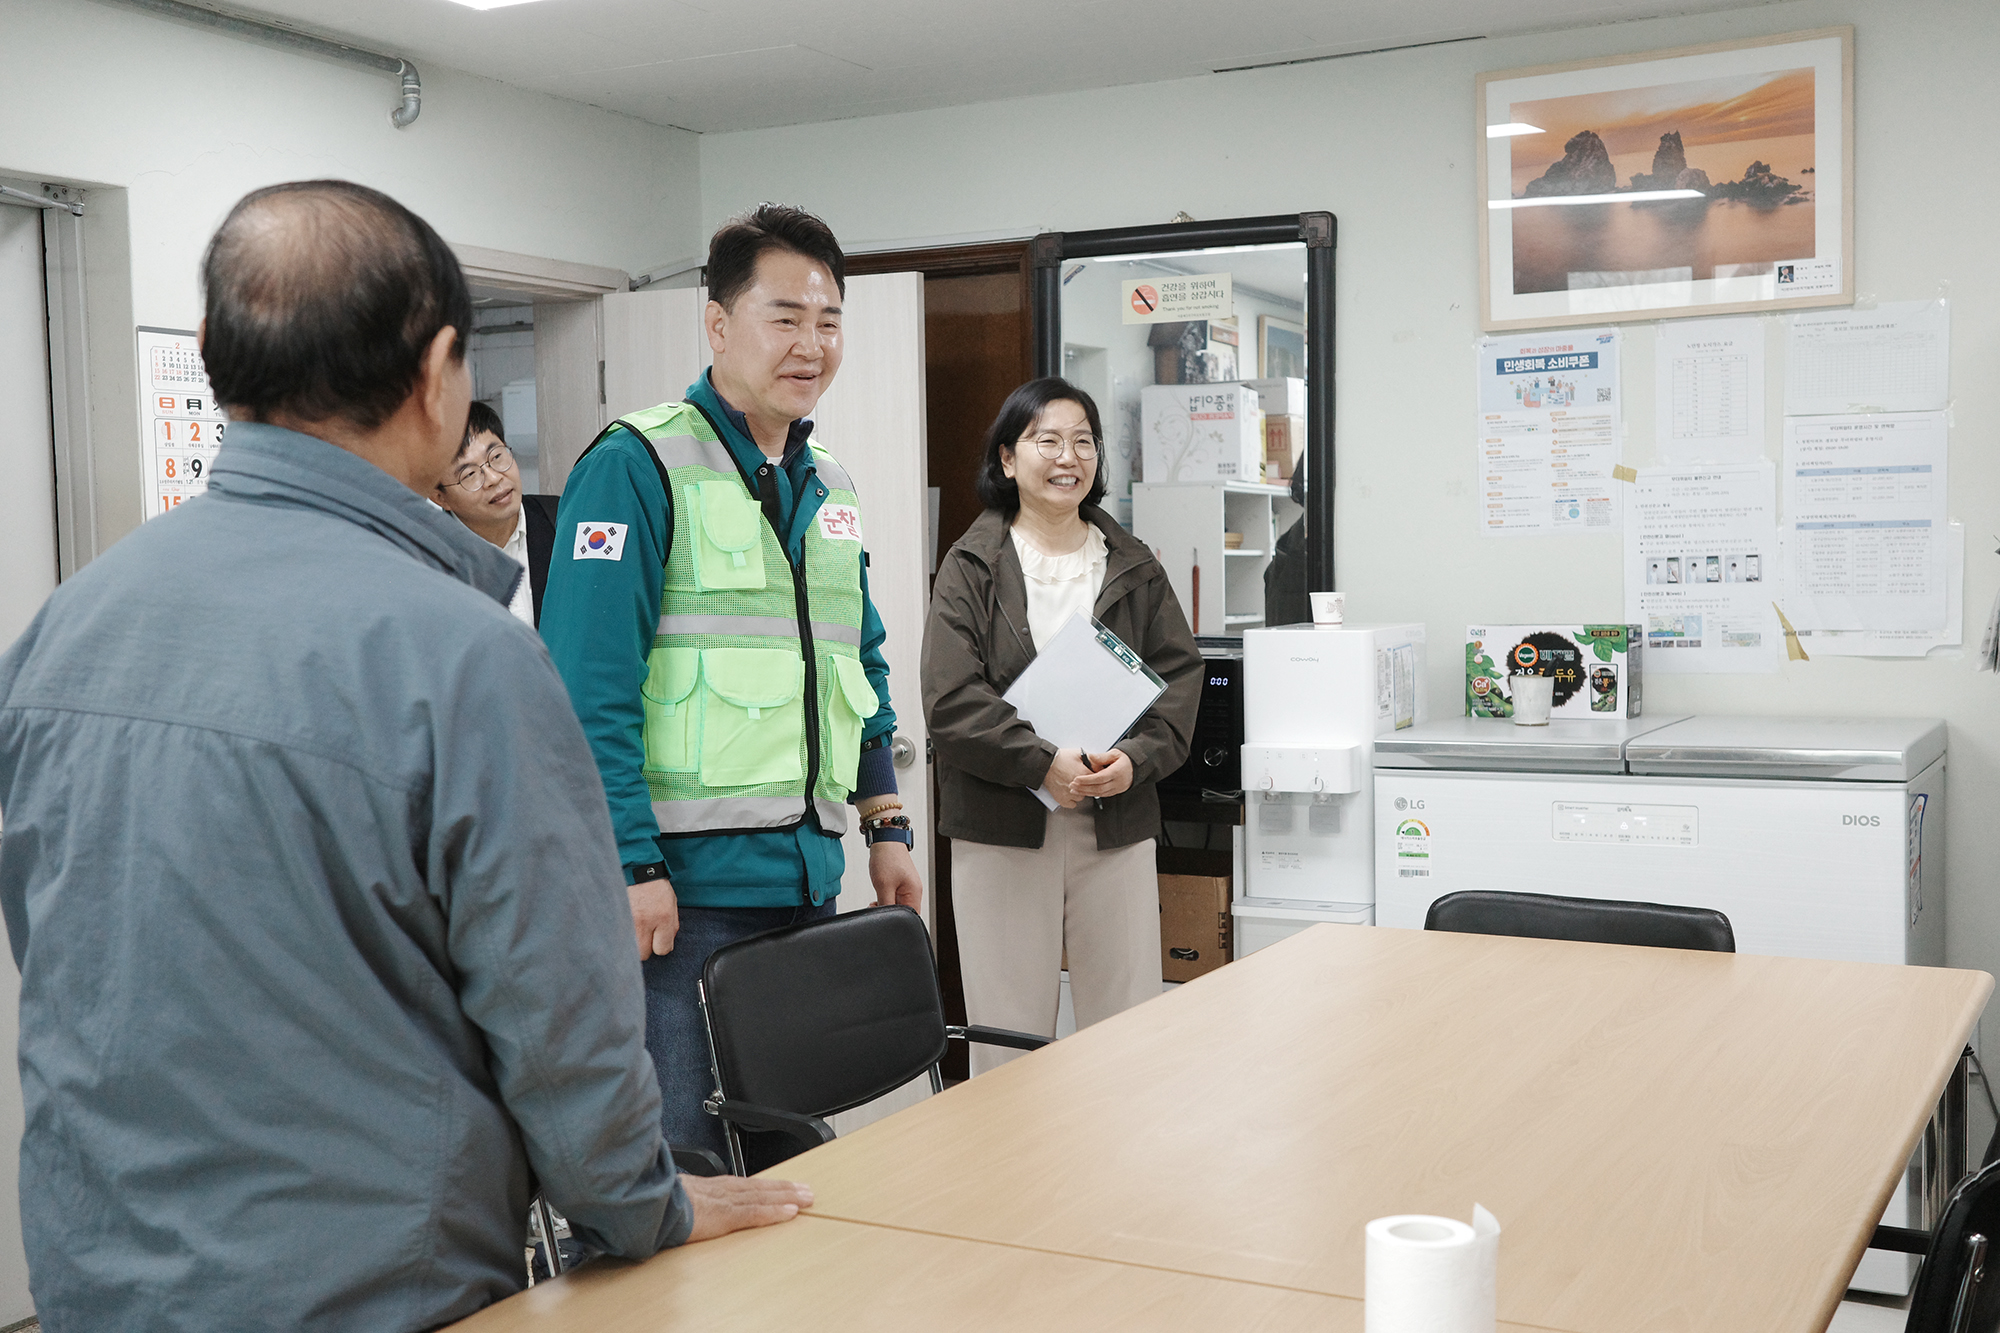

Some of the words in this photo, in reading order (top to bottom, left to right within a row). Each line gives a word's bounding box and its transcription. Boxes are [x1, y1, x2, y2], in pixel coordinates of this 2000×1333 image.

[1161, 282, 1186, 292] 건강을
[1190, 280, 1216, 290] 위하여
[1162, 292, 1187, 302] 흡연을
[1191, 290, 1224, 300] 삼갑시다
[175, 342, 180, 350] 2
[1504, 358, 1546, 372] 민생회복
[1547, 354, 1590, 370] 소비쿠폰
[164, 421, 172, 440] 1
[189, 422, 201, 442] 2
[215, 423, 225, 443] 3
[165, 458, 177, 478] 8
[191, 459, 203, 478] 9
[823, 508, 860, 539] 순찰
[1555, 668, 1577, 683] 두유
[1410, 799, 1425, 810] LG
[1842, 814, 1881, 827] DIOS
